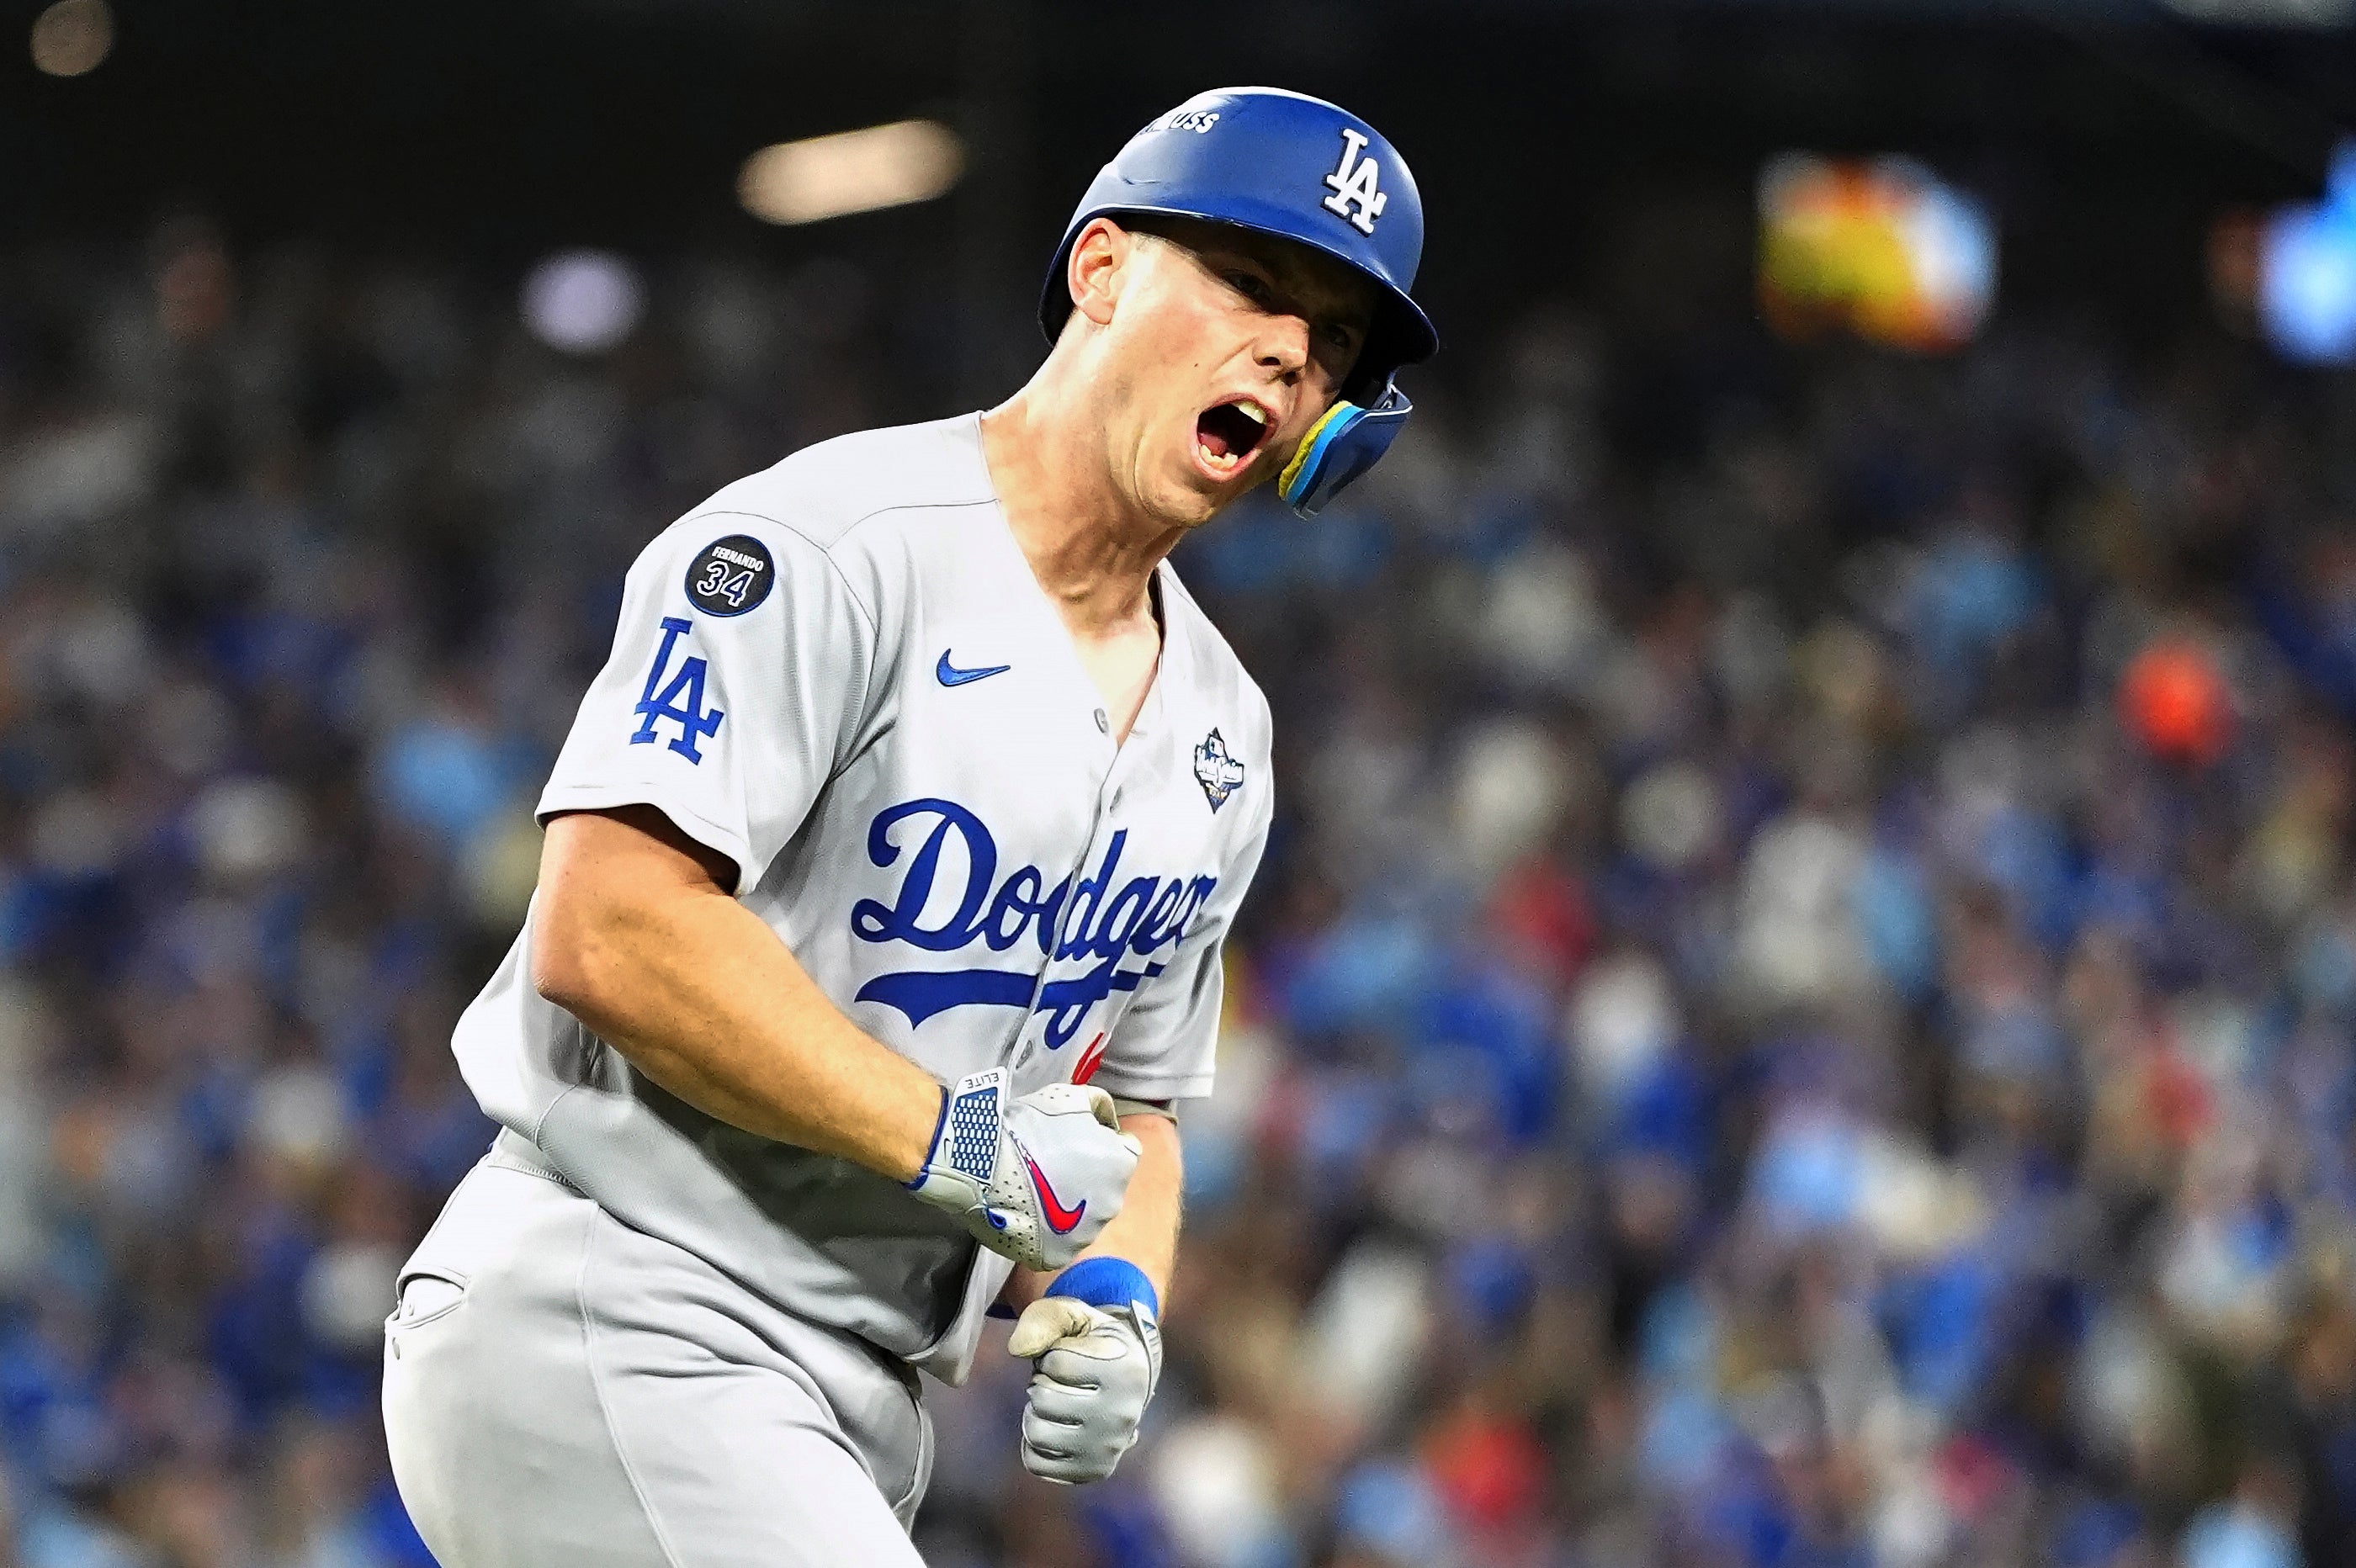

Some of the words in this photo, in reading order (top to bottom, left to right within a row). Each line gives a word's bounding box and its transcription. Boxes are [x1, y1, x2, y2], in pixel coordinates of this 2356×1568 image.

[1322, 128, 1388, 235] LA
[696, 560, 755, 607] 34
[712, 546, 764, 572] FERNANDO
[629, 617, 724, 765] LA
[851, 797, 1218, 1050] Dodger
[964, 1073, 1000, 1089] ELITE
